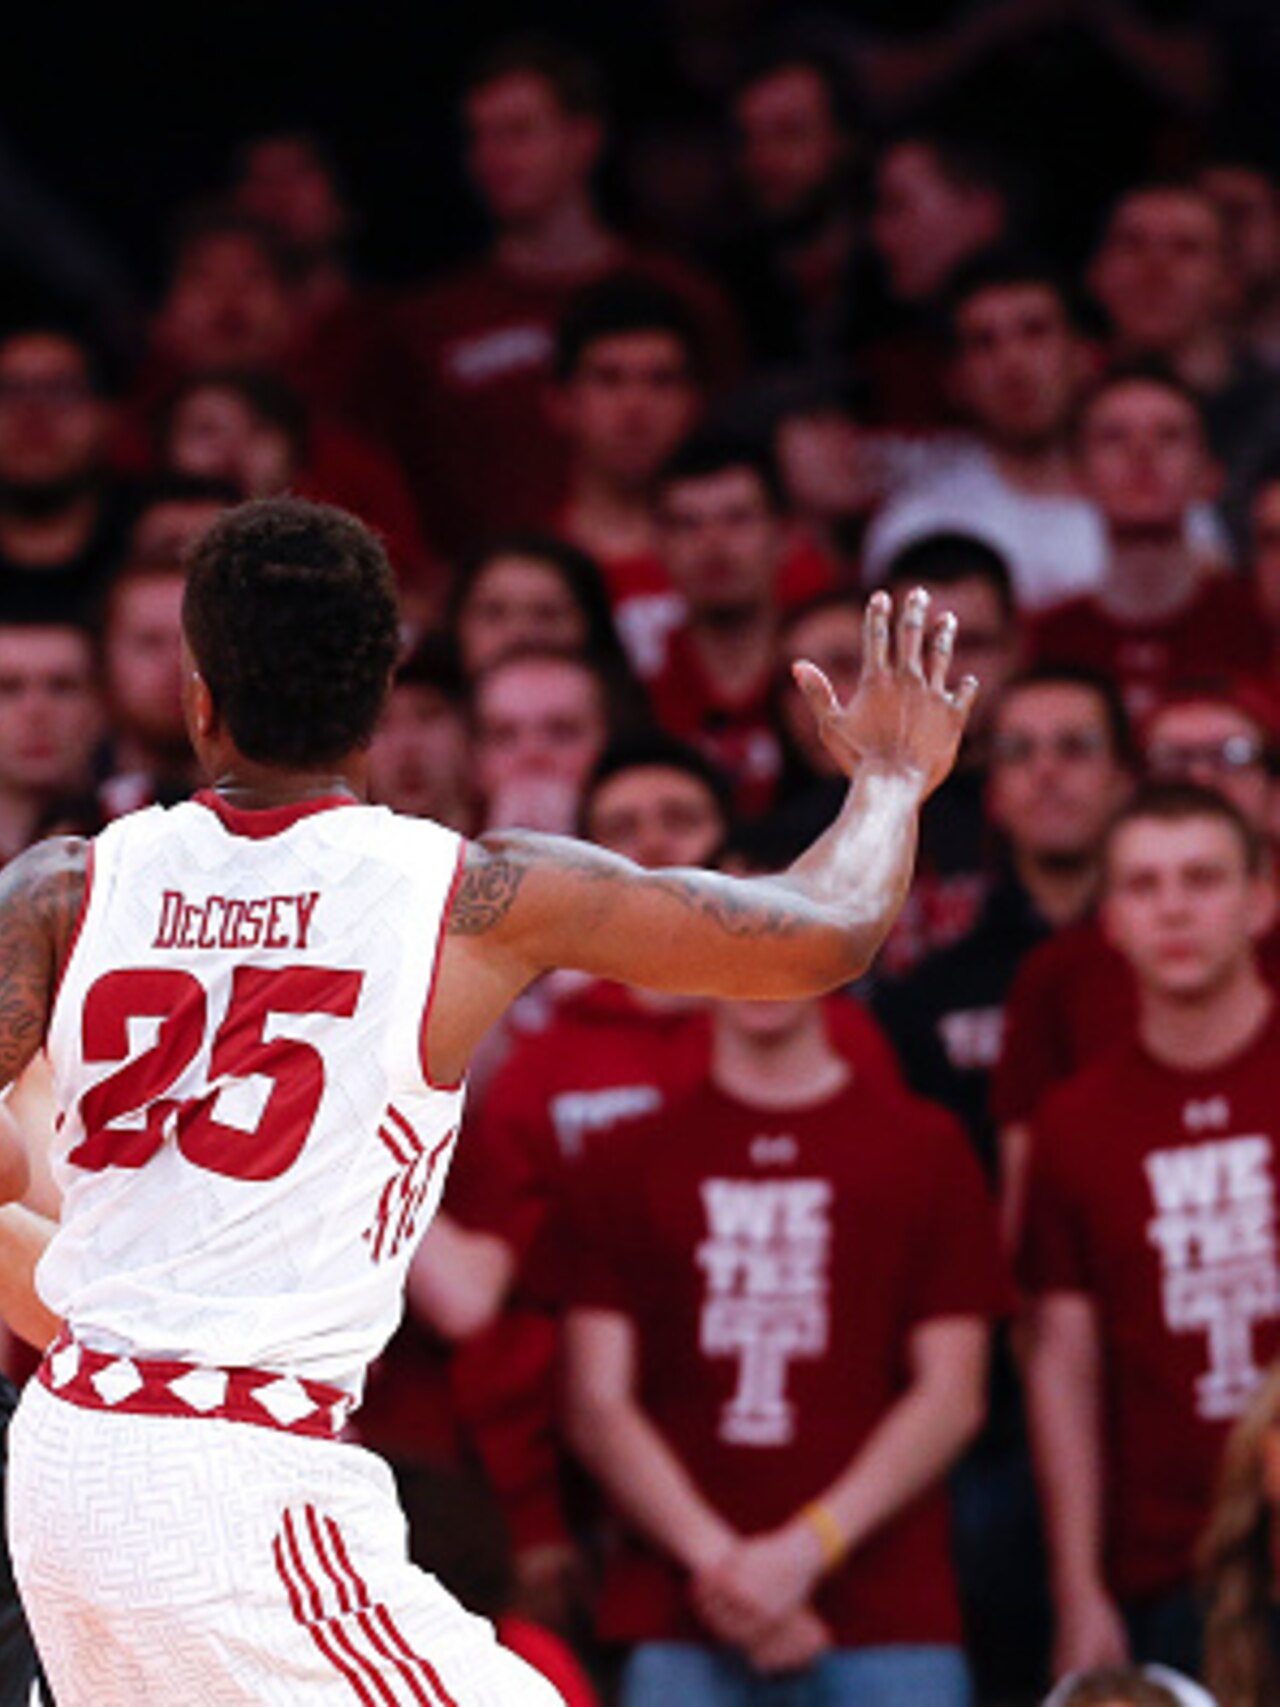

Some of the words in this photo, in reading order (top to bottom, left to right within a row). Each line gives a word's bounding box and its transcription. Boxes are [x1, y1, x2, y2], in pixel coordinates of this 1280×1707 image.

[66, 965, 366, 1182] 25
[1143, 1137, 1272, 1208] WE
[701, 1177, 831, 1240] WE
